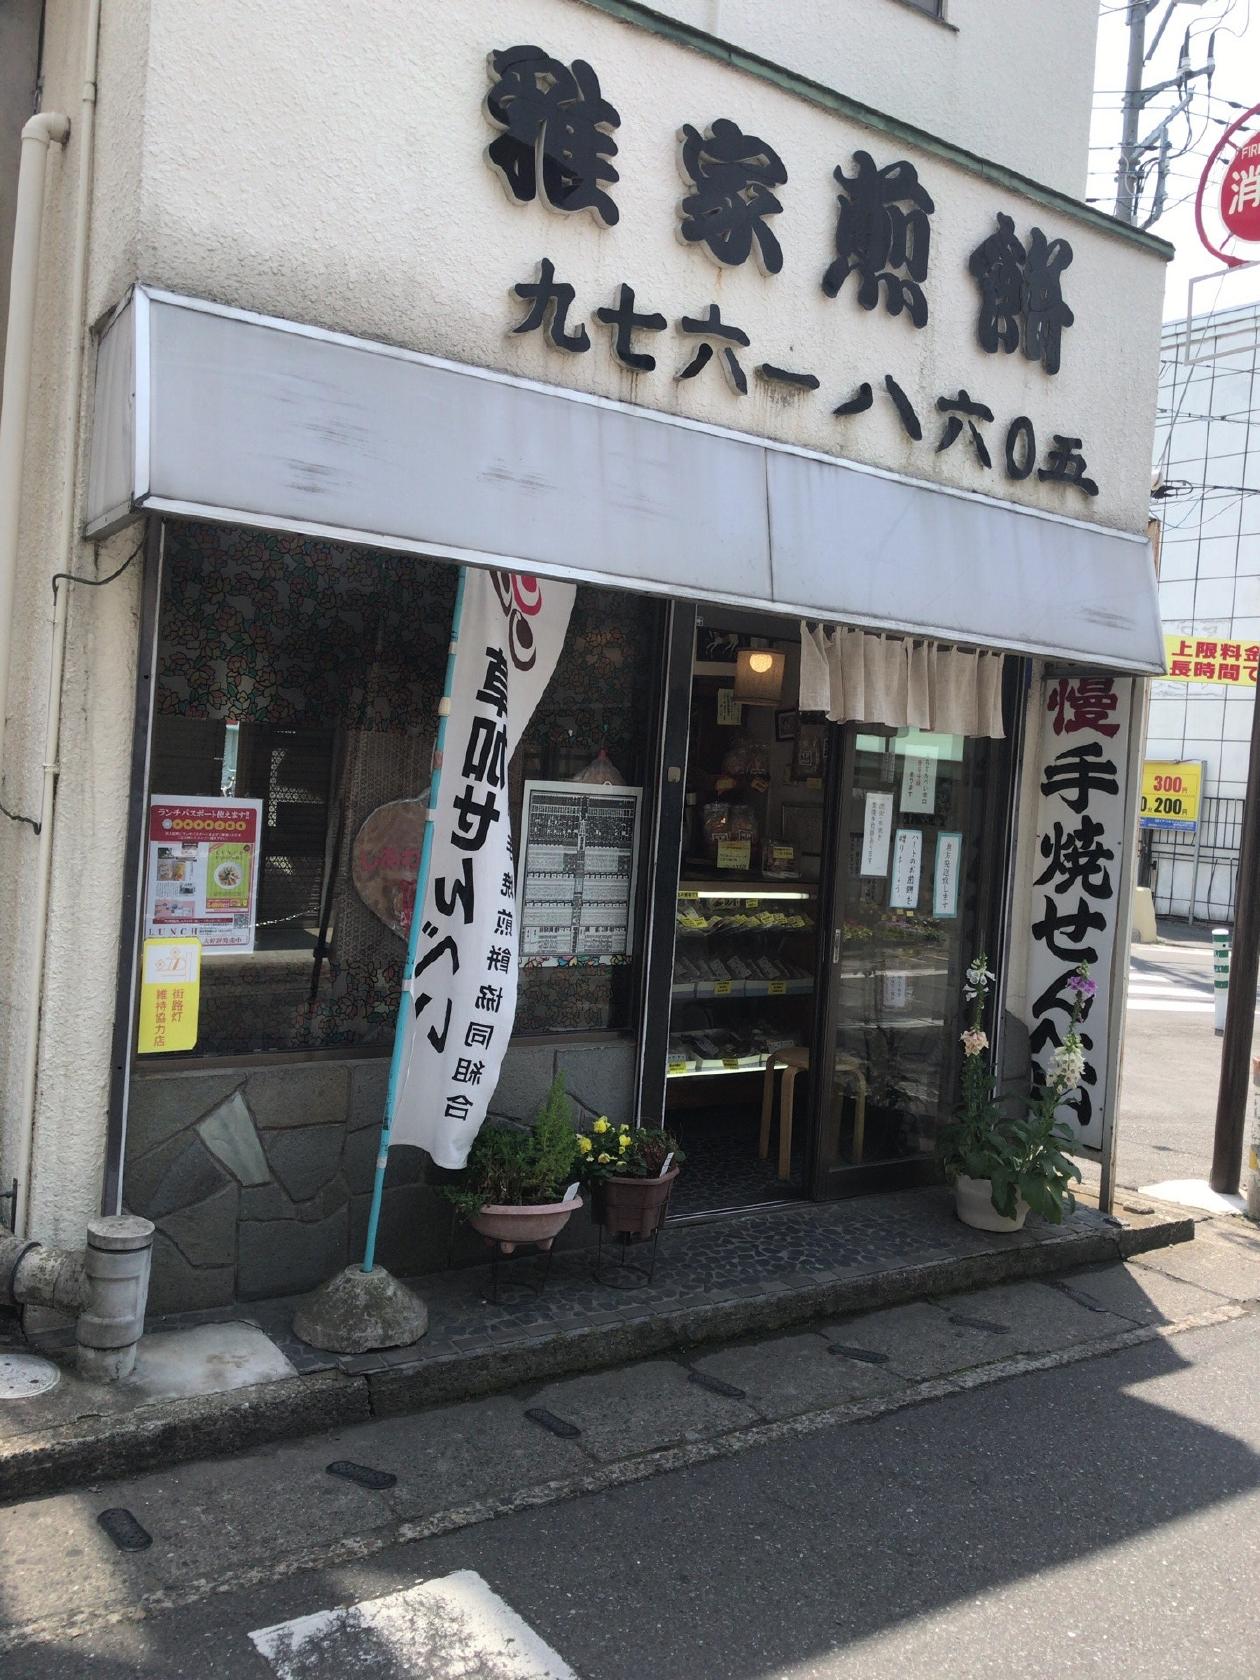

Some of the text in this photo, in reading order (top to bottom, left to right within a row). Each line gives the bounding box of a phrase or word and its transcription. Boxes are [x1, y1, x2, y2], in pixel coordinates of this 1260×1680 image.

[1171, 640, 1260, 663] 上限料金
[148, 927, 198, 936] LUNCH
[154, 989, 168, 1047] 維持協力店
[171, 988, 184, 1024] 街路灯
